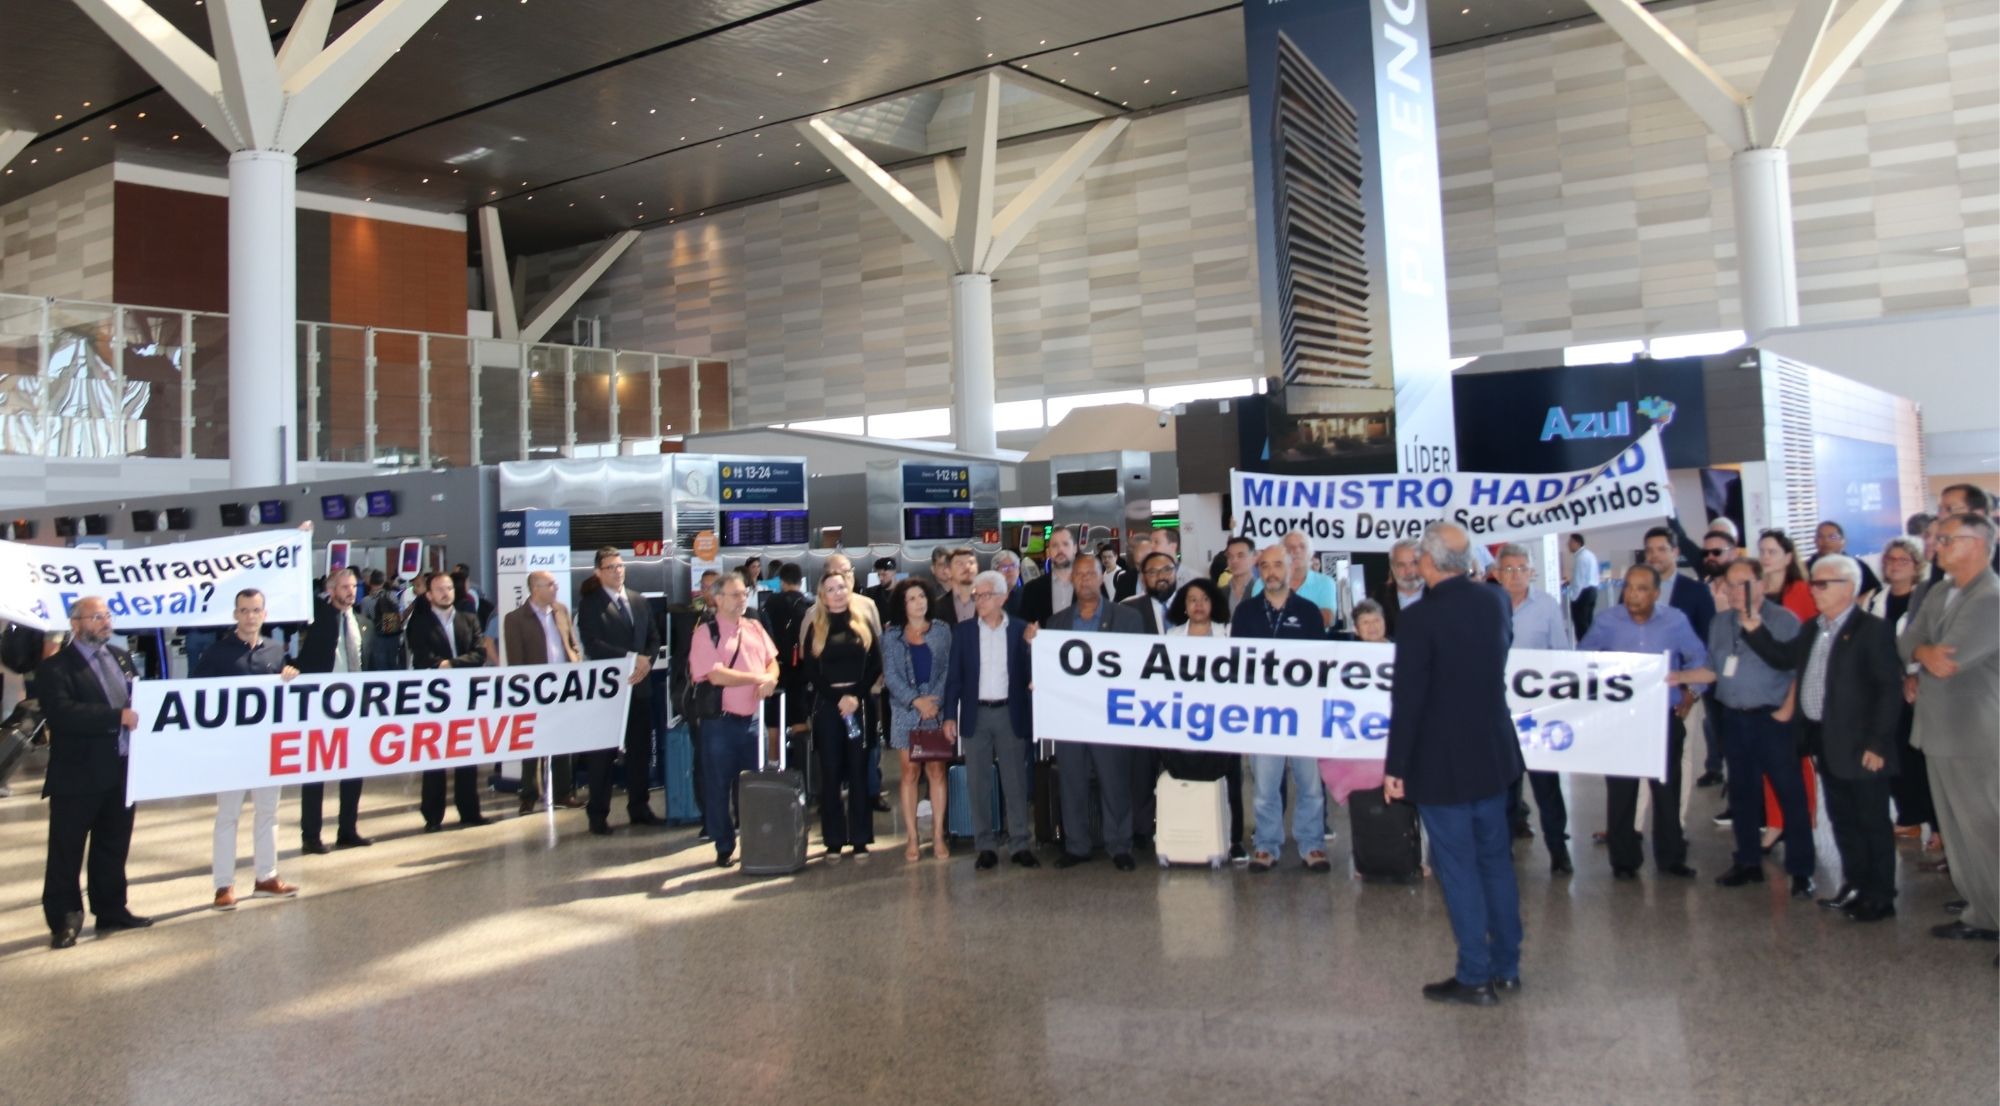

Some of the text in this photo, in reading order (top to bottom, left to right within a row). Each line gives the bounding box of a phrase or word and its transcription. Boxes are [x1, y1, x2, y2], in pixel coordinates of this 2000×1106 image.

[1540, 401, 1630, 441] Azul
[1404, 435, 1451, 472] LÍDER
[1240, 510, 1345, 539] Acordos
[1454, 508, 1498, 534] Ser
[1507, 480, 1660, 528] Cumpridos
[1242, 477, 1453, 510] MINISTRO
[93, 544, 302, 584] Enfraquecer
[530, 553, 555, 566] Azul
[60, 582, 215, 619] Fderal?
[1058, 639, 1122, 680] Os
[1140, 643, 1394, 691] Auditores
[151, 666, 621, 732] AUDITORES FISCAIS
[1106, 688, 1299, 742] Exigem
[269, 713, 538, 777] EM GREVE
